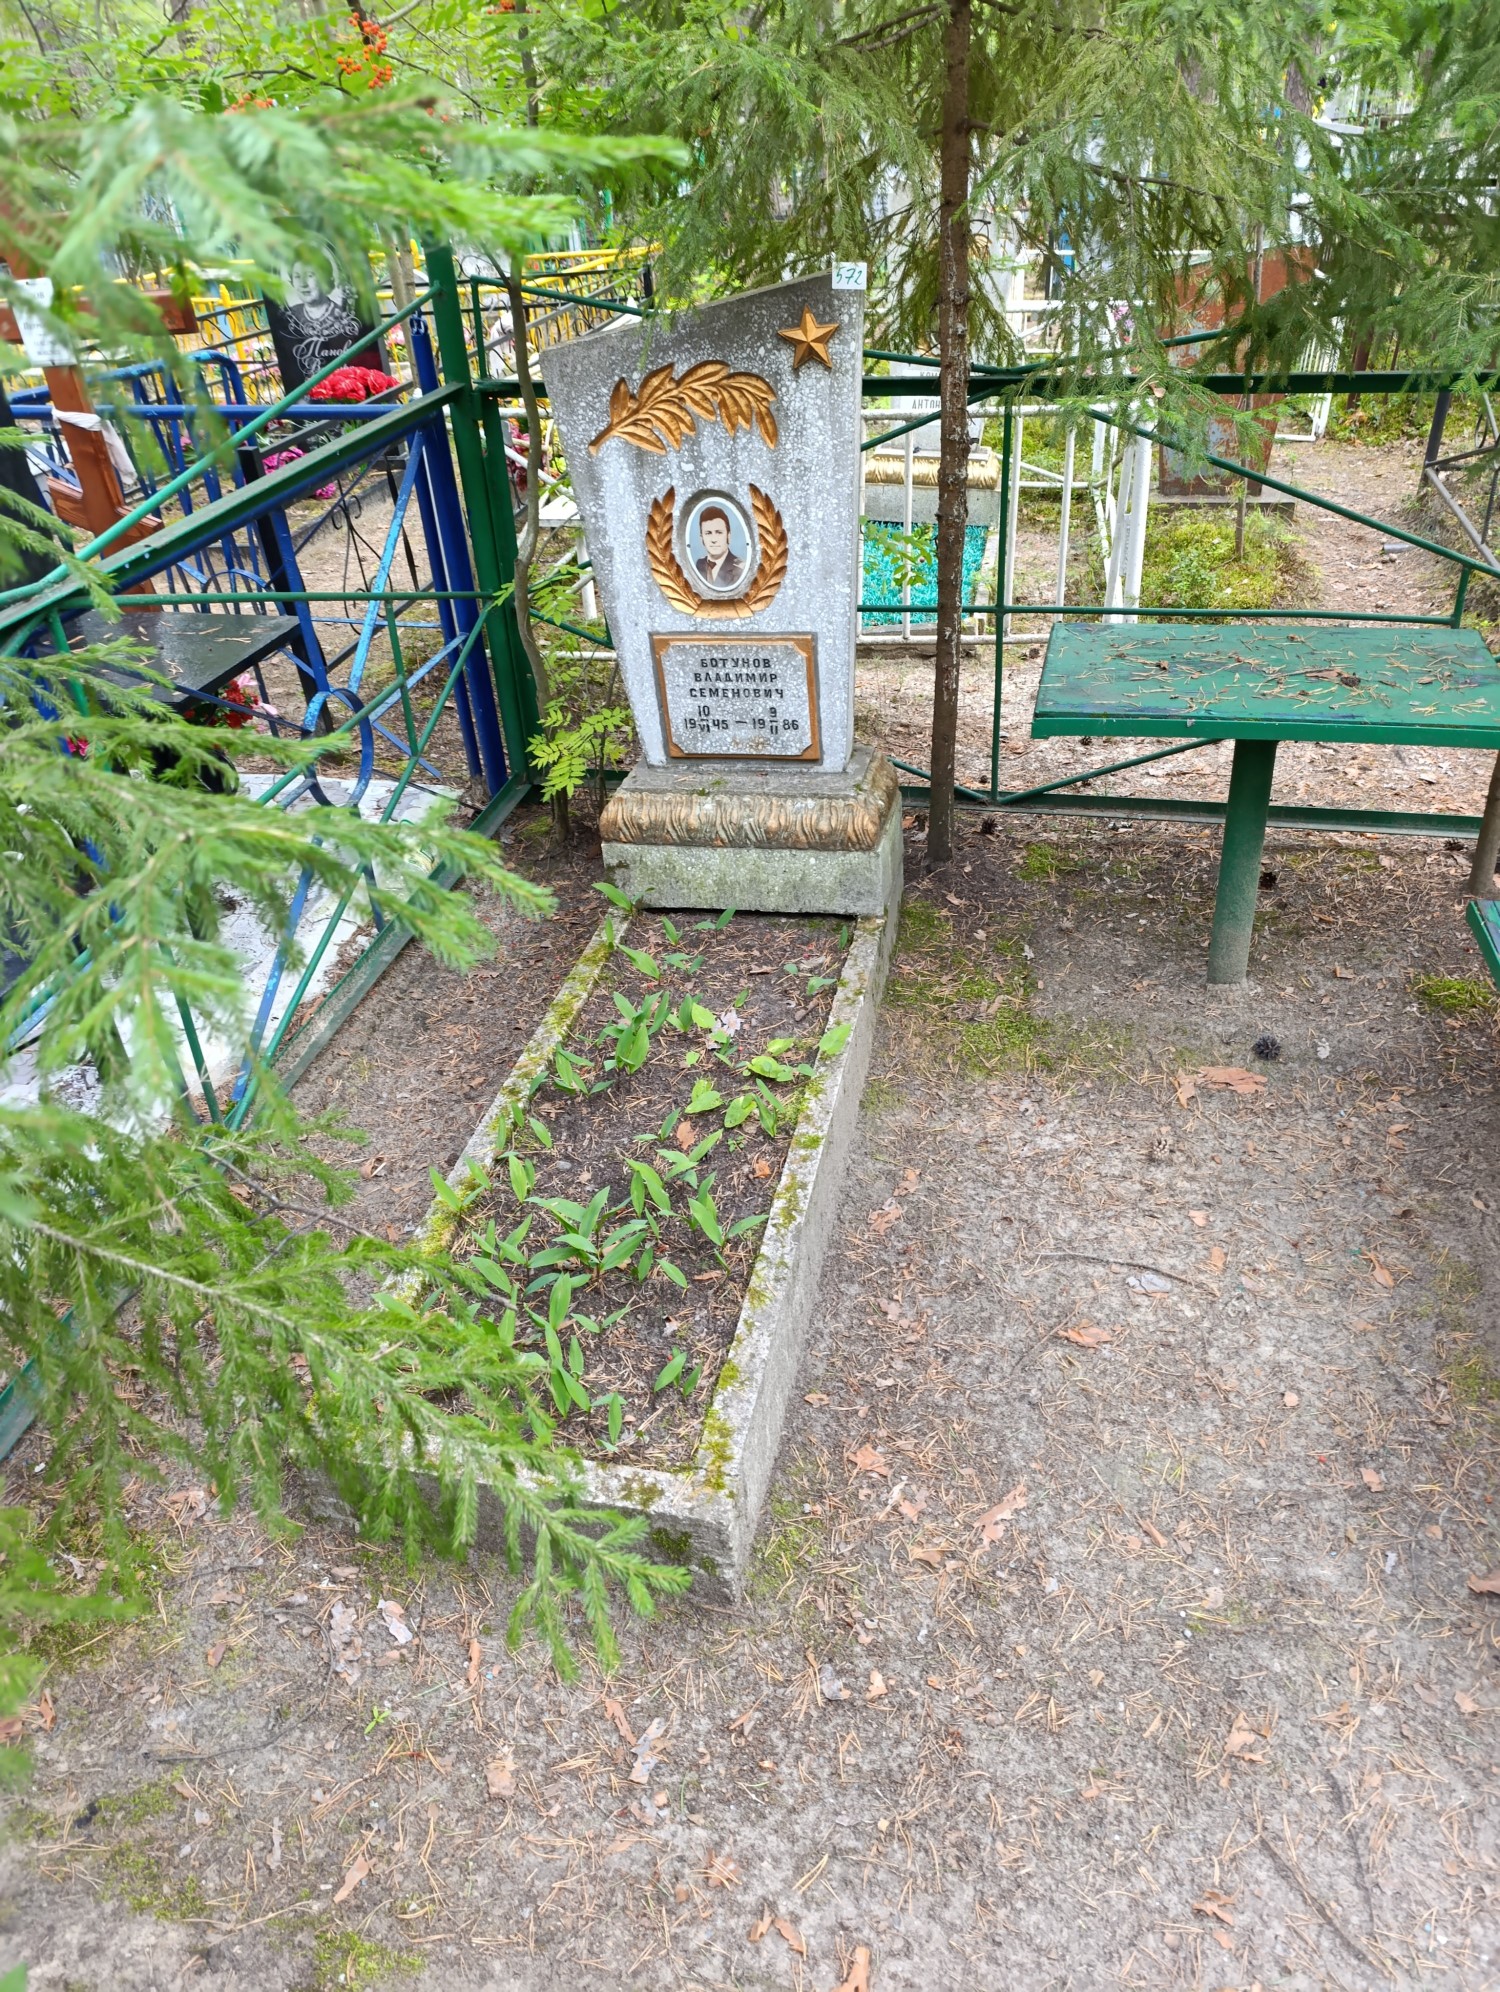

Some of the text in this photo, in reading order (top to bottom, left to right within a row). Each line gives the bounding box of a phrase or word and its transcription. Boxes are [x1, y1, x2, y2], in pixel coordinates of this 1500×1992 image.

[836, 266, 863, 286] 572
[293, 336, 352, 359] Панов
[911, 398, 941, 410] АНТОН
[701, 658, 772, 669] БОТУНОВ
[694, 672, 778, 683] ВЛАДИМИР
[689, 688, 784, 699] СЕМЕНОВИЧ
